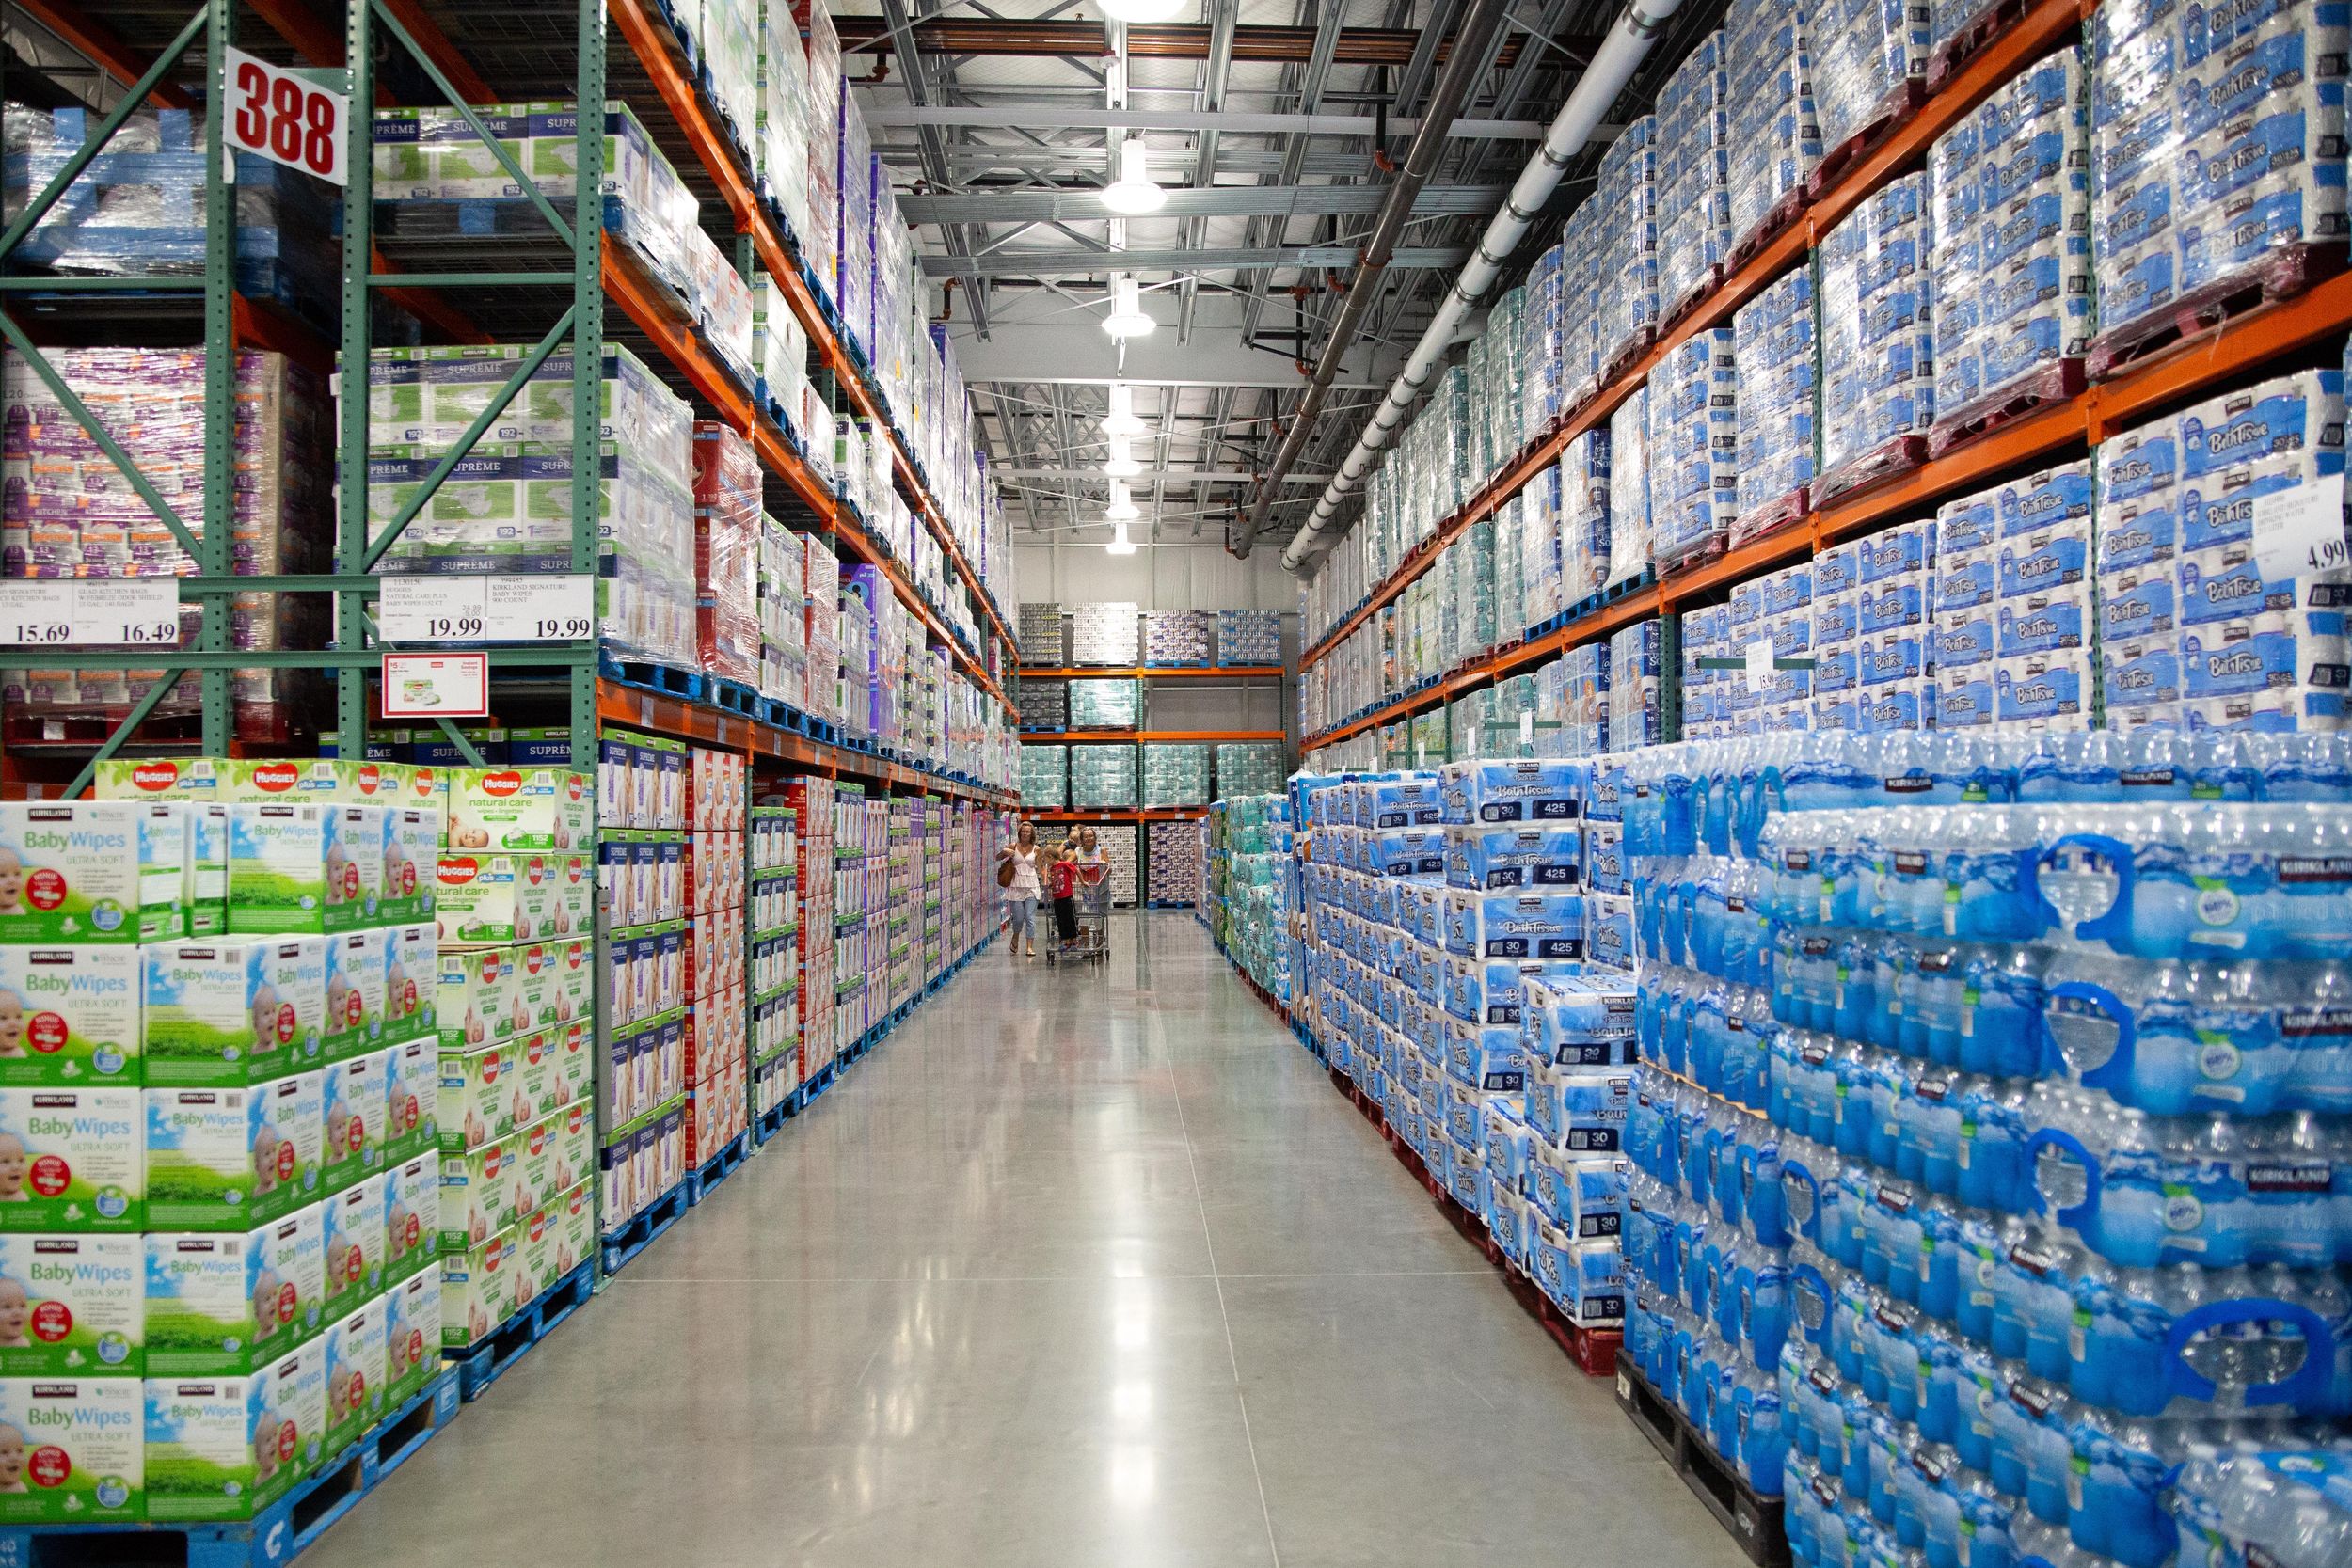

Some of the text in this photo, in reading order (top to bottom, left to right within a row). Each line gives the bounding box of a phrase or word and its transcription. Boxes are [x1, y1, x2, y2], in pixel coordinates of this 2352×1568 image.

[235, 63, 335, 176] 388
[501, 429, 516, 437] 192
[407, 529, 422, 537] 192
[499, 527, 515, 536] 192
[2308, 540, 2344, 569] 4.99
[429, 618, 482, 636] 19.99
[536, 619, 590, 638] 19.99
[16, 625, 70, 642] 15.69
[121, 624, 175, 641] 16.49
[1759, 673, 1774, 689] 15.99
[529, 744, 571, 755] SUPRÊM
[135, 771, 175, 782] HUGGIES
[255, 772, 296, 783] HUGGIES
[485, 779, 519, 789] HUGGIES
[521, 786, 537, 795] plus
[469, 798, 507, 807] natural
[30, 808, 72, 816] KIRKLAND
[1545, 803, 1566, 813] 425
[24, 831, 126, 853] BabyWipes
[437, 866, 475, 876] HUGGIES
[1545, 869, 1566, 878] 425
[478, 874, 494, 882] plus
[490, 925, 508, 933] 1152
[1506, 942, 1519, 950] 30
[1550, 942, 1572, 952] 425
[32, 952, 72, 960] KIRKLAND
[26, 974, 127, 996] BabyWipes
[2286, 1013, 2352, 1026] KIRKLAN
[1584, 1047, 1599, 1056] 30
[34, 1096, 76, 1104] KIRKLAND
[29, 1117, 131, 1140] BabyWipes
[1593, 1132, 1608, 1142] 30
[1601, 1217, 1617, 1227] 30
[445, 1232, 463, 1241] 1152
[31, 1262, 133, 1286] BabyWipes
[1606, 1300, 1619, 1309] 30
[444, 1328, 463, 1337] 1152
[34, 1386, 76, 1394] KIRKLAND
[28, 1407, 132, 1430] BabyWipes
